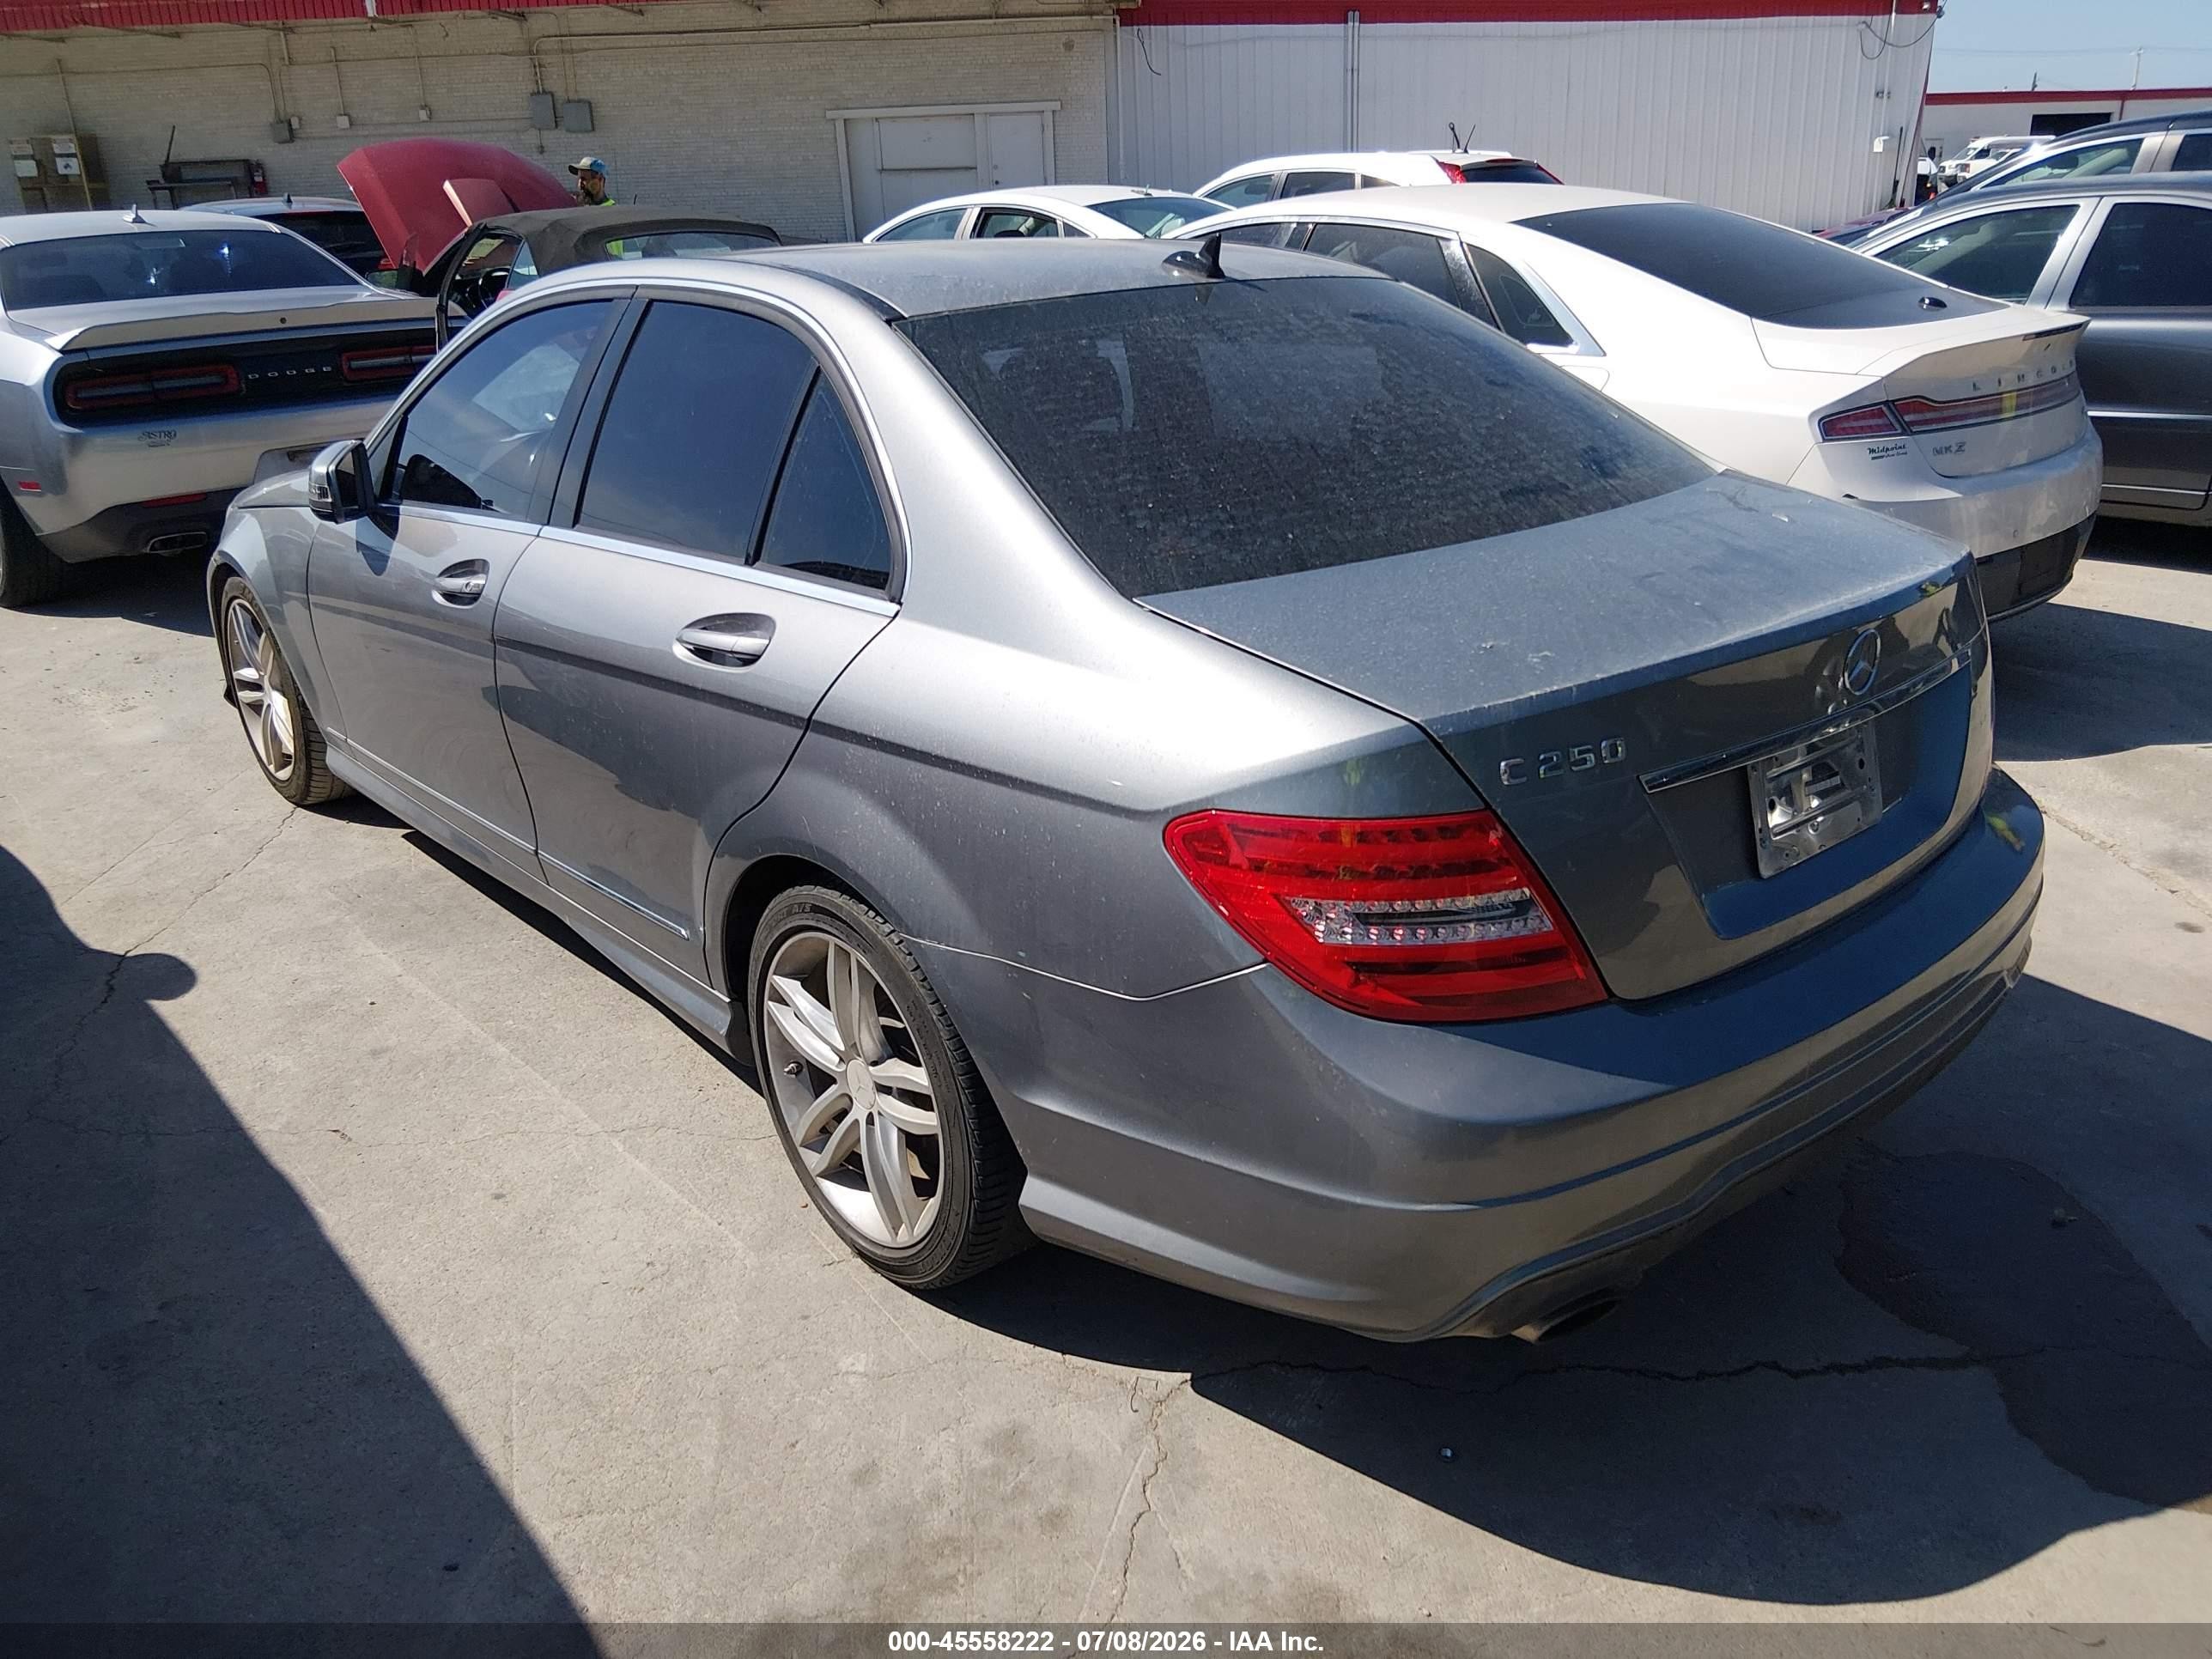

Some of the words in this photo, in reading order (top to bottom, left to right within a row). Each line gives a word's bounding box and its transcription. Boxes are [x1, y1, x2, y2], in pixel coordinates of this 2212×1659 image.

[247, 366, 332, 380] DODGE
[1499, 757, 1528, 786] C
[1538, 737, 1628, 779] 250
